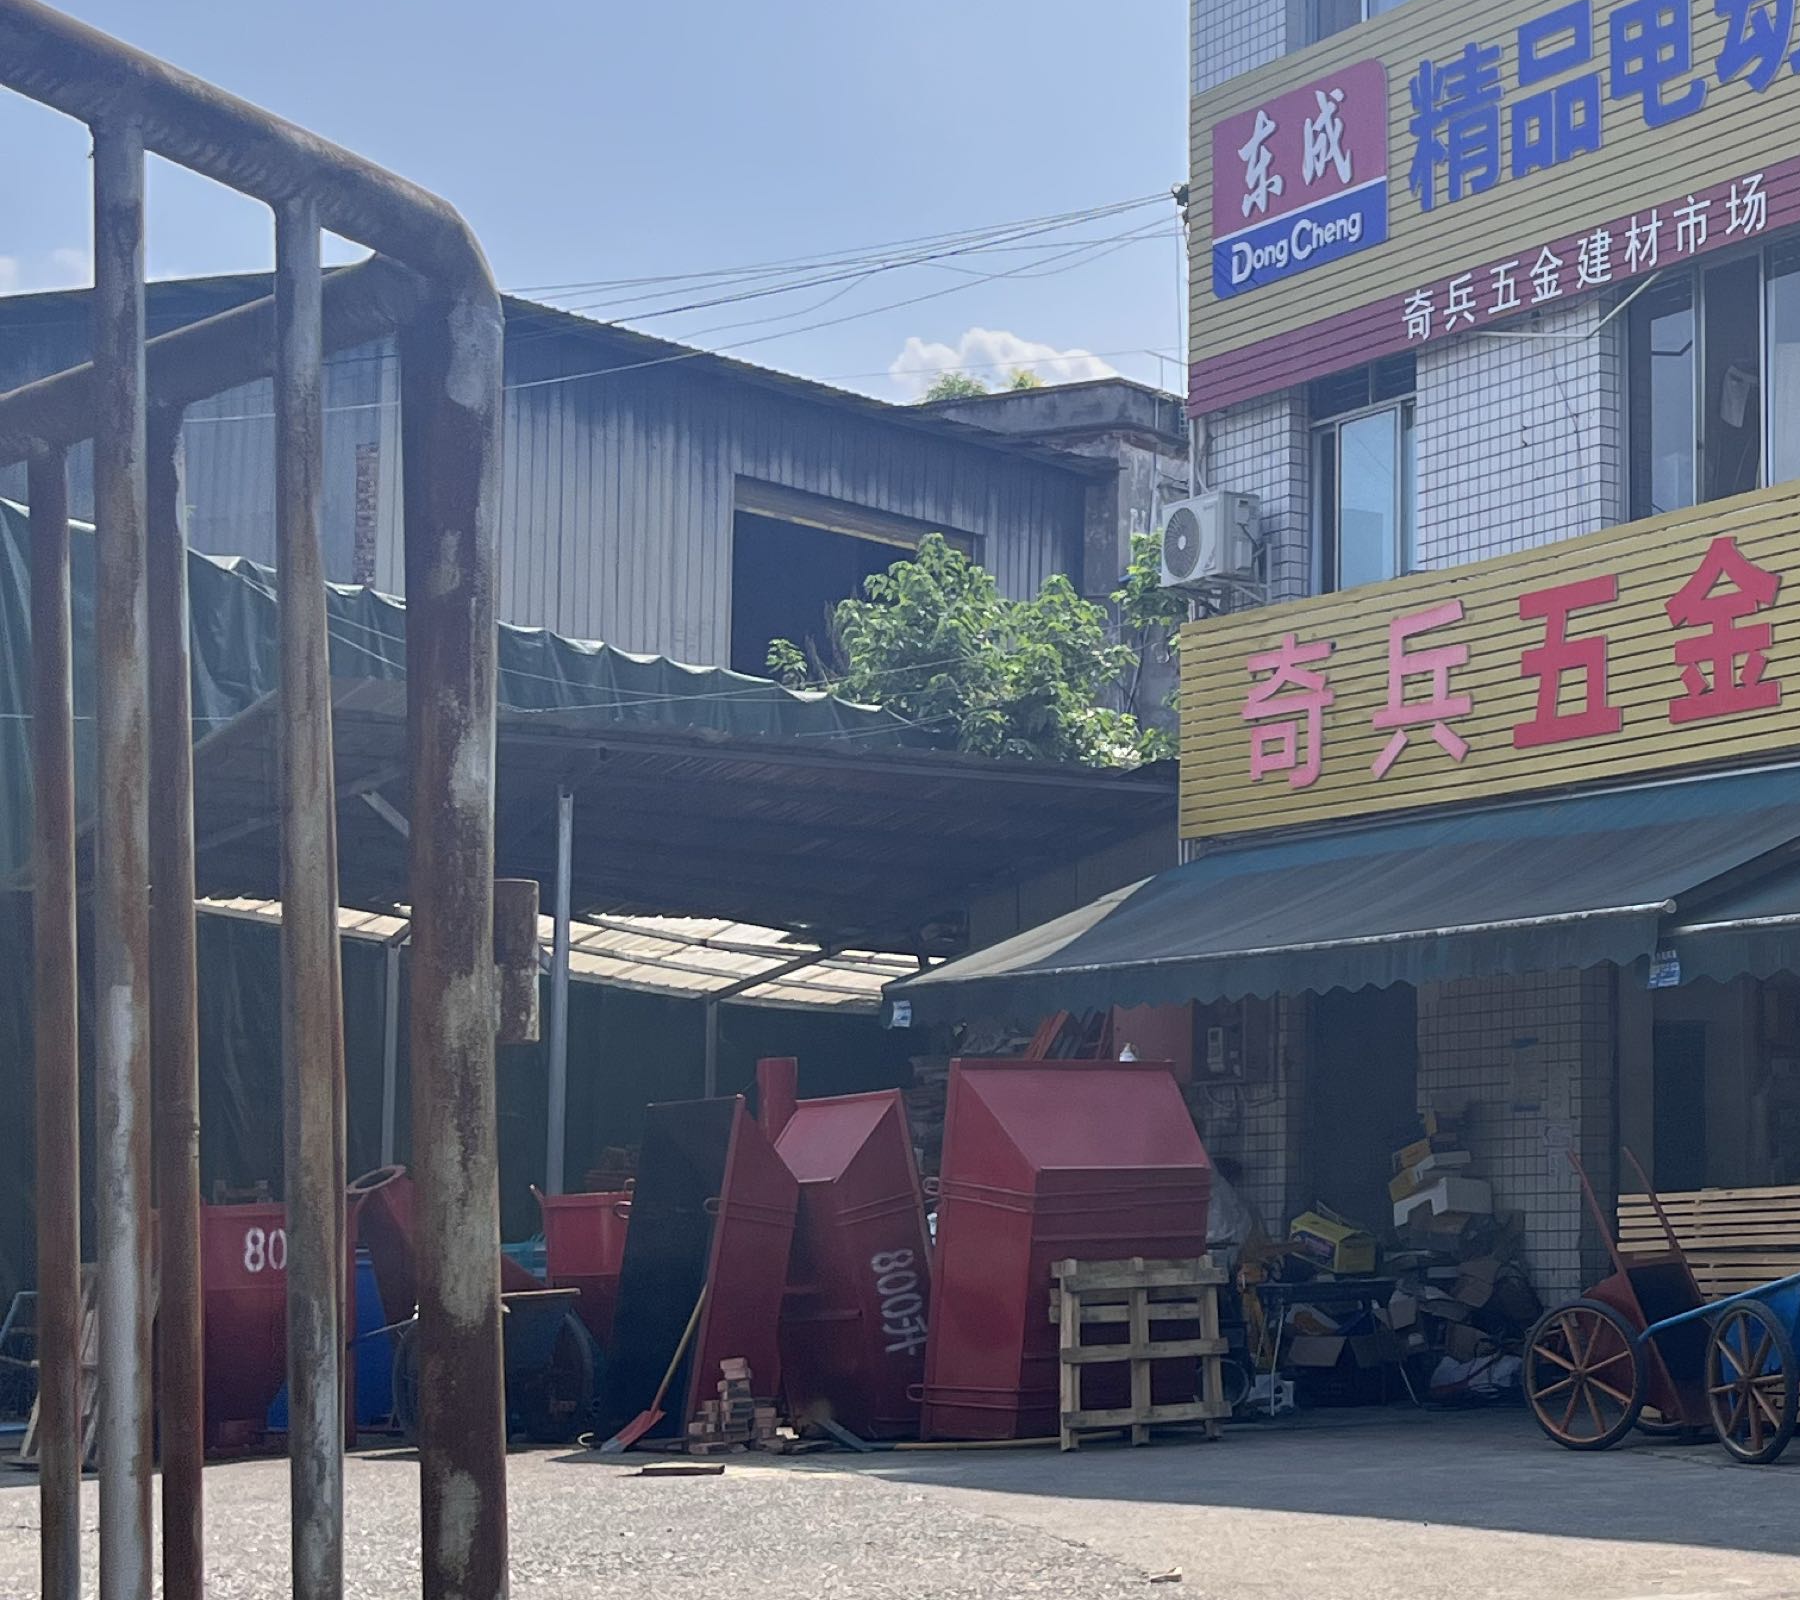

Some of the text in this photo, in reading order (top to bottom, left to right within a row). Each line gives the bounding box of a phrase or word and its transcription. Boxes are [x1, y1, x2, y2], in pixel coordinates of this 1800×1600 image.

[1236, 88, 1354, 219] 东成
[1401, 172, 1769, 342] 奇兵五金建材市场
